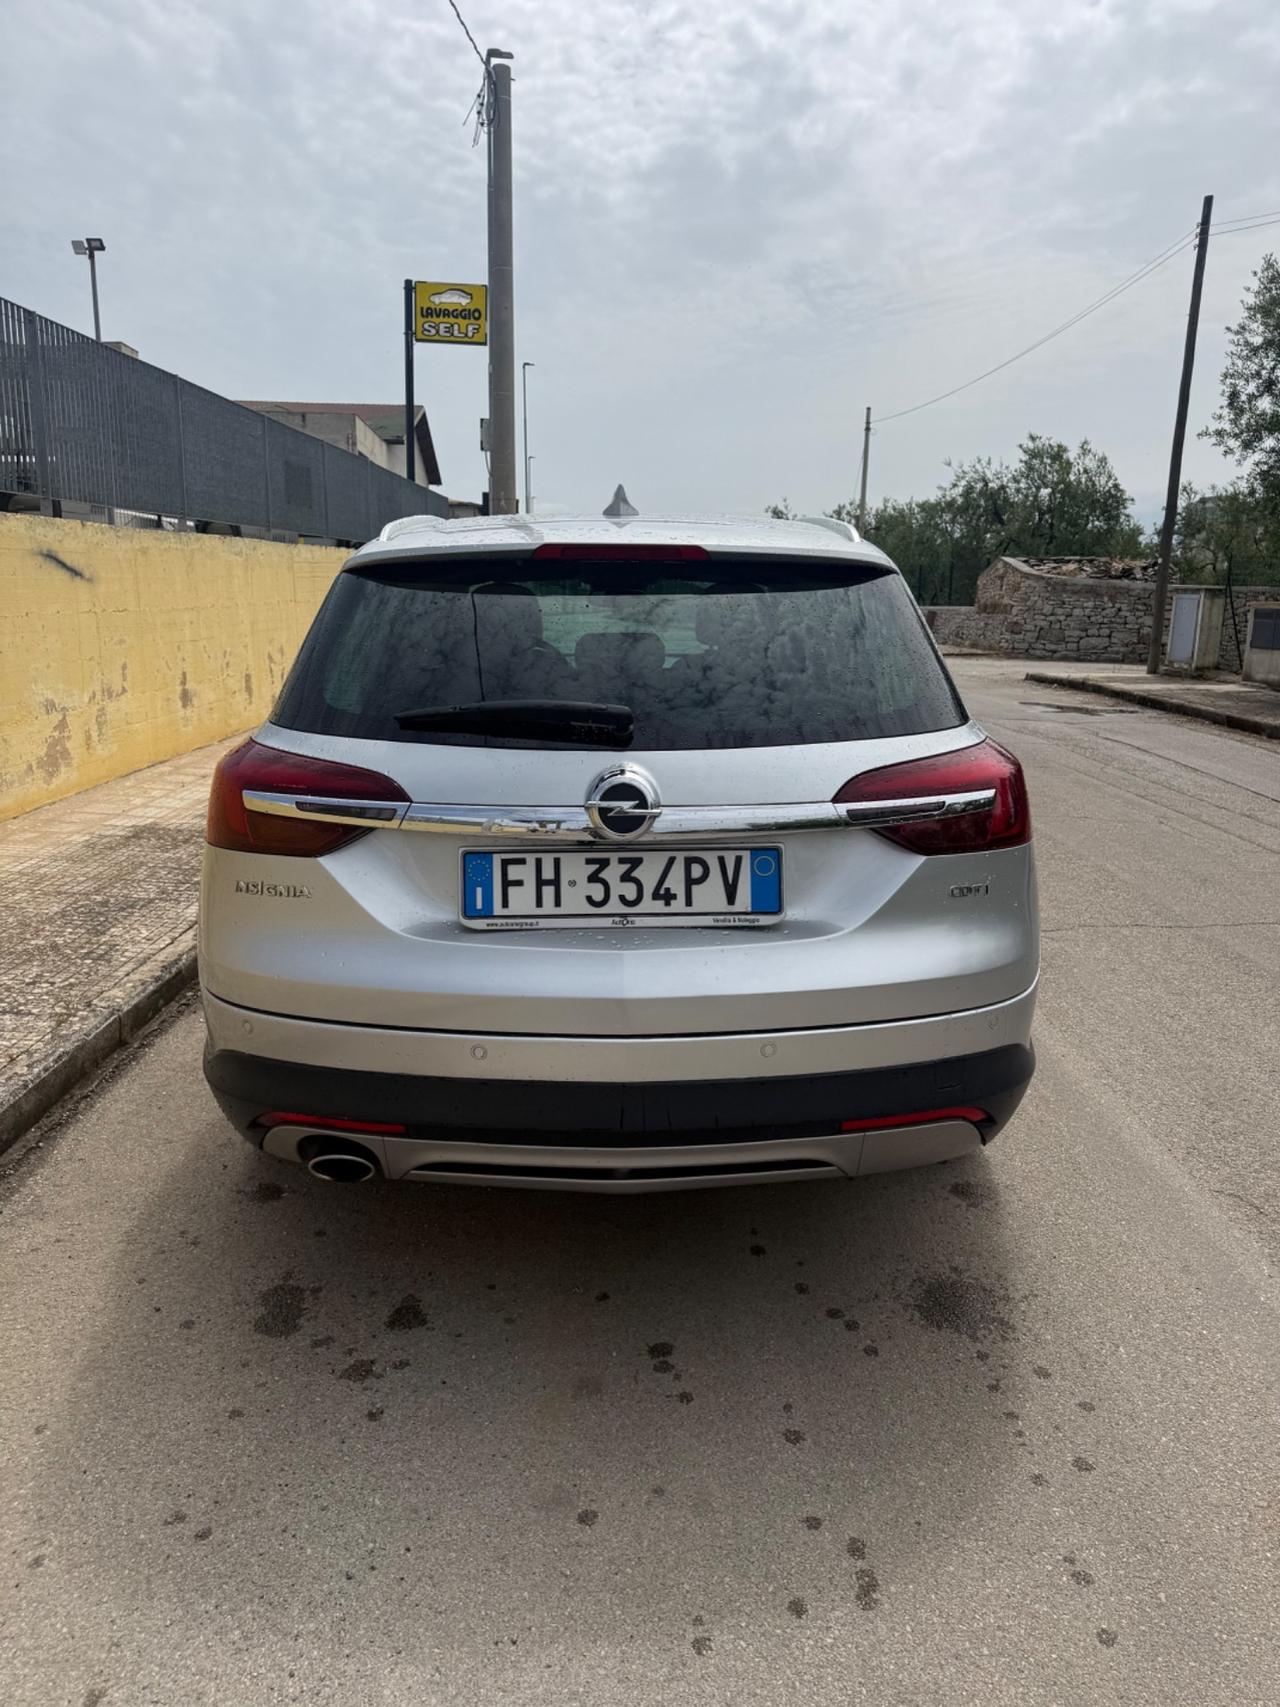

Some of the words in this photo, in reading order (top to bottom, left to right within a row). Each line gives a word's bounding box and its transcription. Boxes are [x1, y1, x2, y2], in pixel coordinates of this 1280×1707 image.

[420, 306, 482, 321] LAVAGGIO
[422, 321, 481, 339] SELF
[500, 857, 561, 909] FH
[584, 855, 743, 908] 334PV
